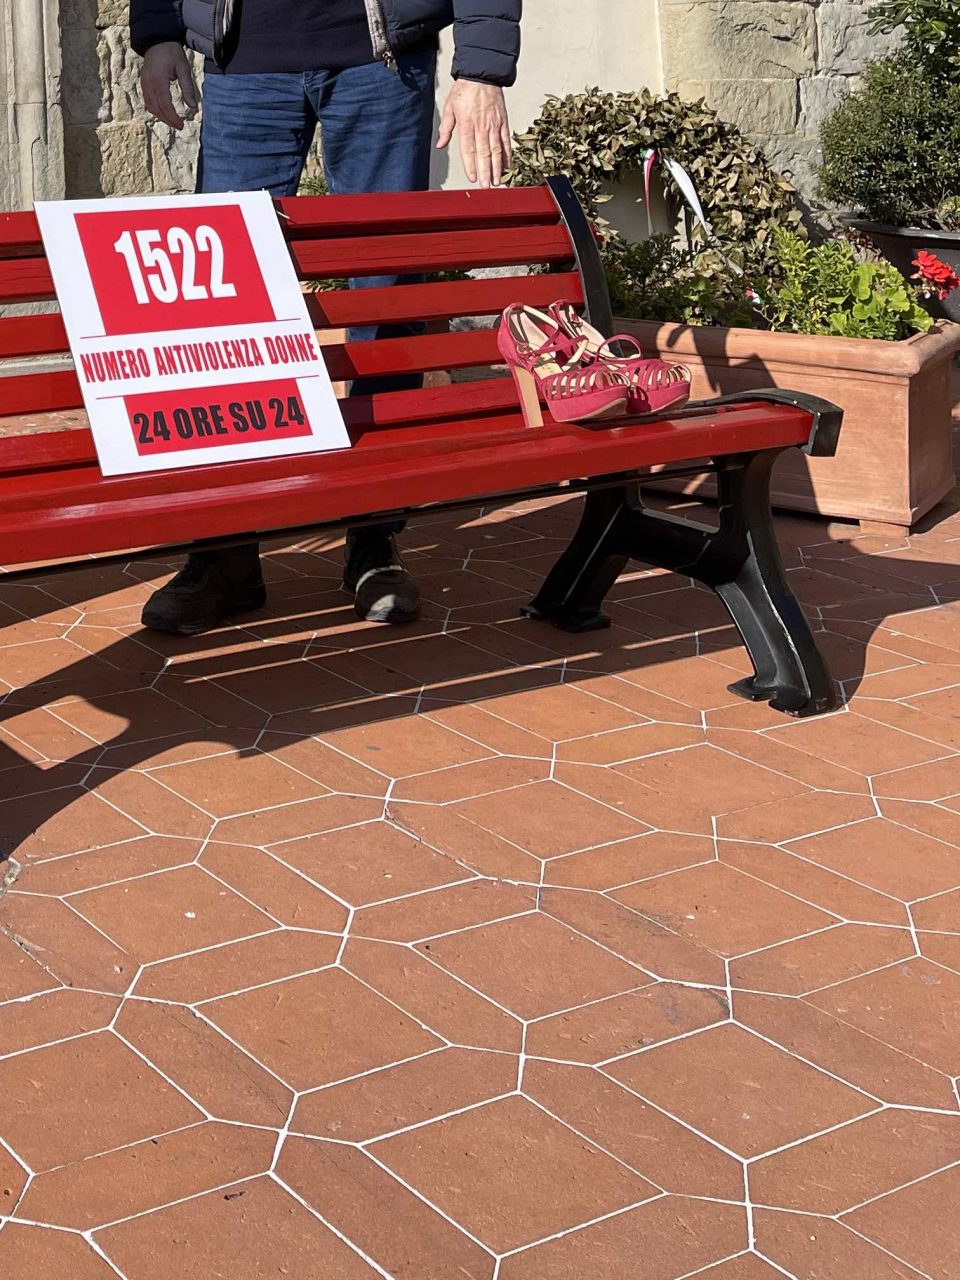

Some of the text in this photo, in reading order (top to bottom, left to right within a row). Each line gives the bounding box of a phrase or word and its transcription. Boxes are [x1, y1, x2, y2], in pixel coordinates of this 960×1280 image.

[113, 224, 237, 305] 1522
[79, 332, 319, 383] NUMERO ANTIVIOLENZA DONNE
[133, 395, 305, 444] 24 ORE SU 24
